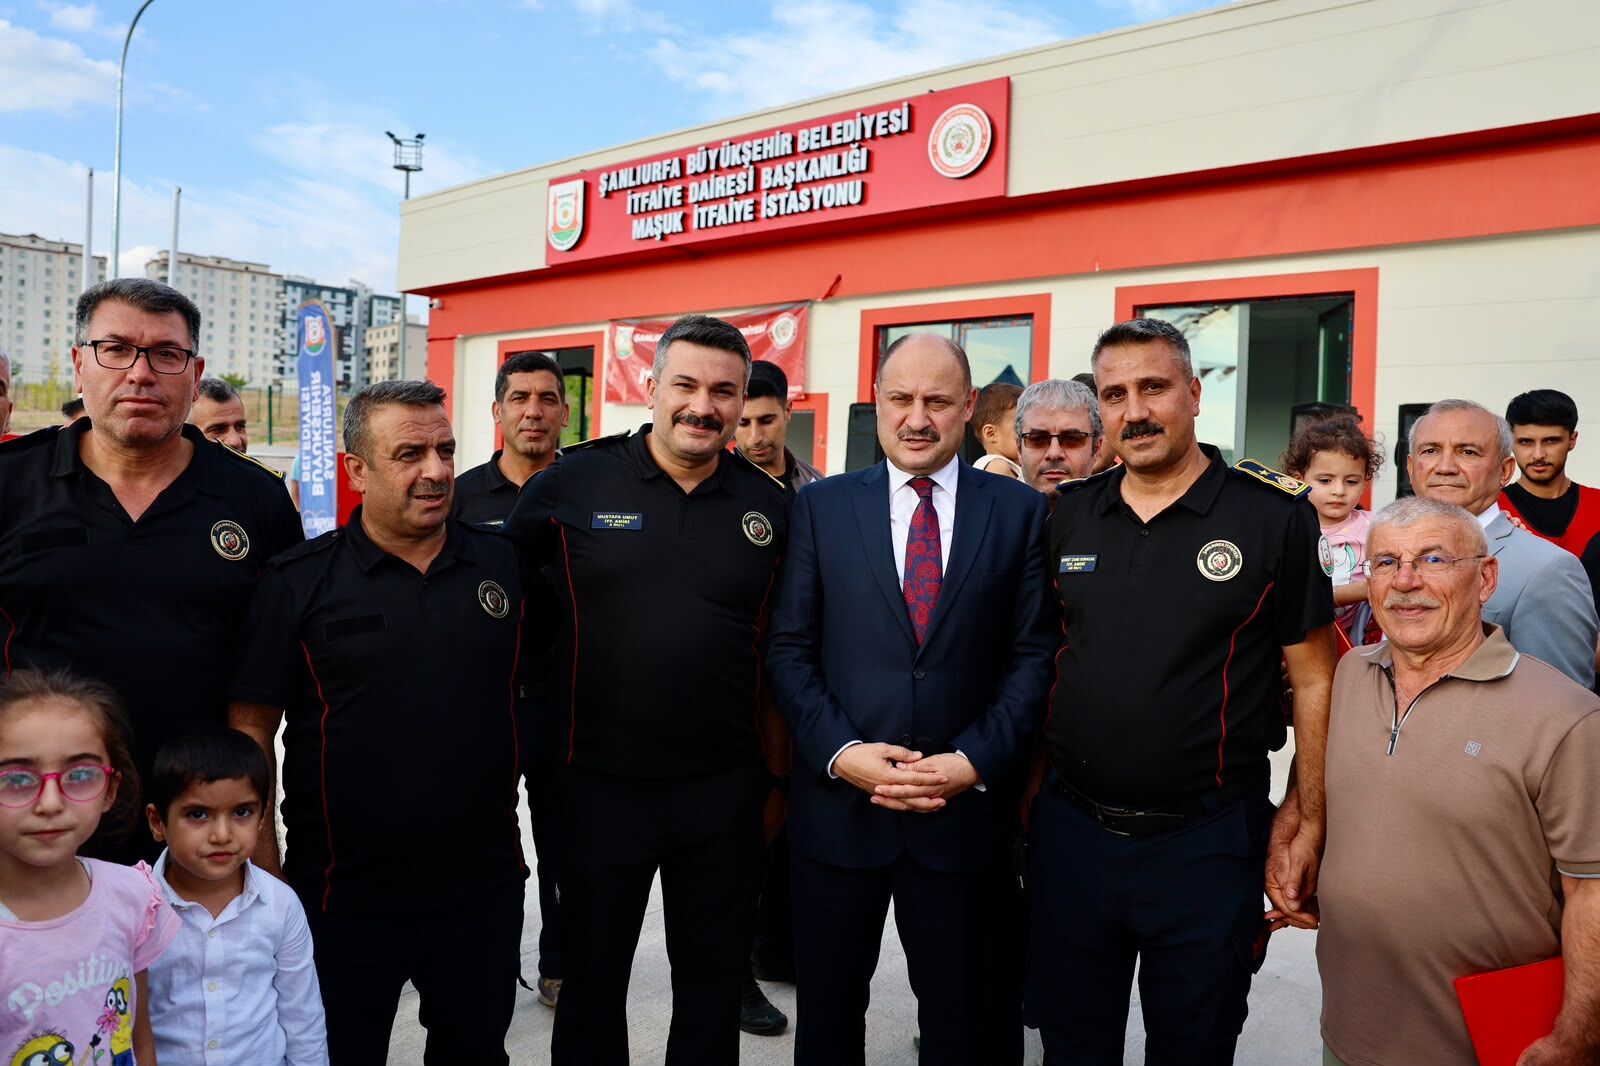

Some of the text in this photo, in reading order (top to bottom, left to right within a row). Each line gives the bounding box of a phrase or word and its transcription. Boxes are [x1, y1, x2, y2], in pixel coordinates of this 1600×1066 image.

[598, 157, 682, 198] ŞANLIURFA
[686, 131, 793, 175] BÜYÜKŞEHİR
[797, 101, 909, 152] BELEDİYESİ
[626, 142, 868, 215] İTFAİYE DAİRESİ BAŞKANLIĞI
[632, 180, 862, 241] MAŞUK İTFAİYE İSTASYONU
